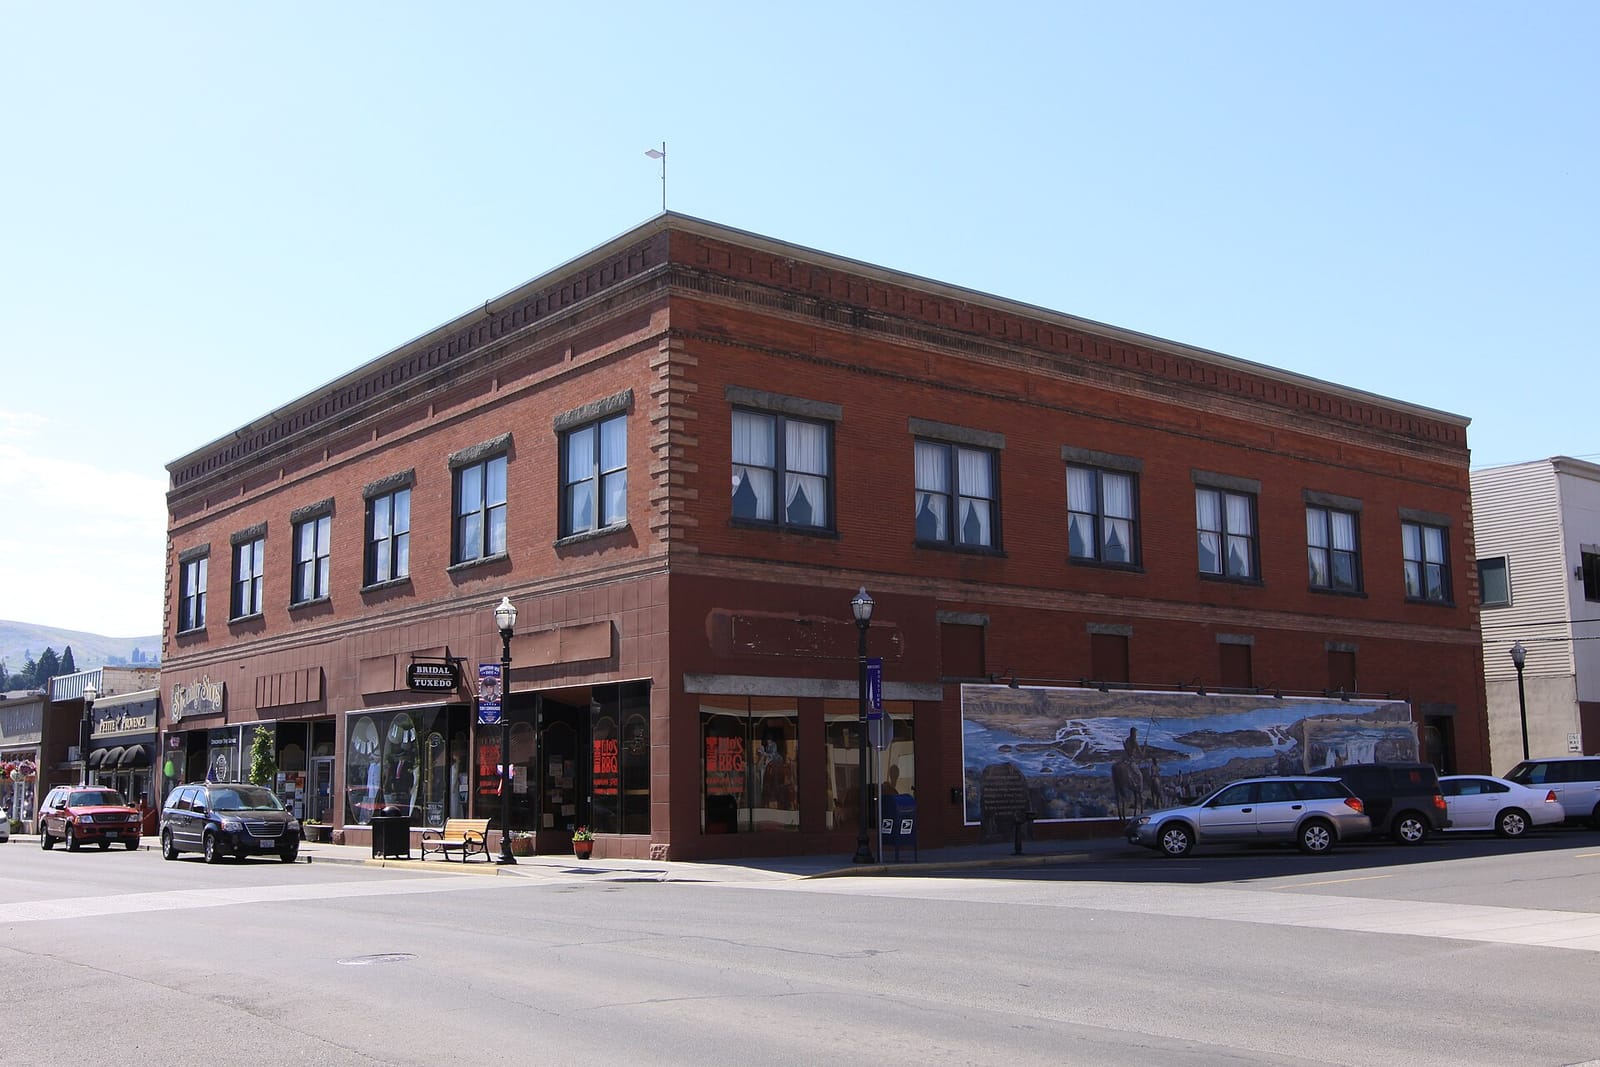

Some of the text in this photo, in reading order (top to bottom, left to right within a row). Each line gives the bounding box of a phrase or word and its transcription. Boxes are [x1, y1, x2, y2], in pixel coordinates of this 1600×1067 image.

[416, 666, 450, 674] BRIDAL
[414, 679, 452, 687] TUXEDO
[99, 715, 147, 733] PETITE PROVENCE
[719, 754, 744, 772] BBQ
